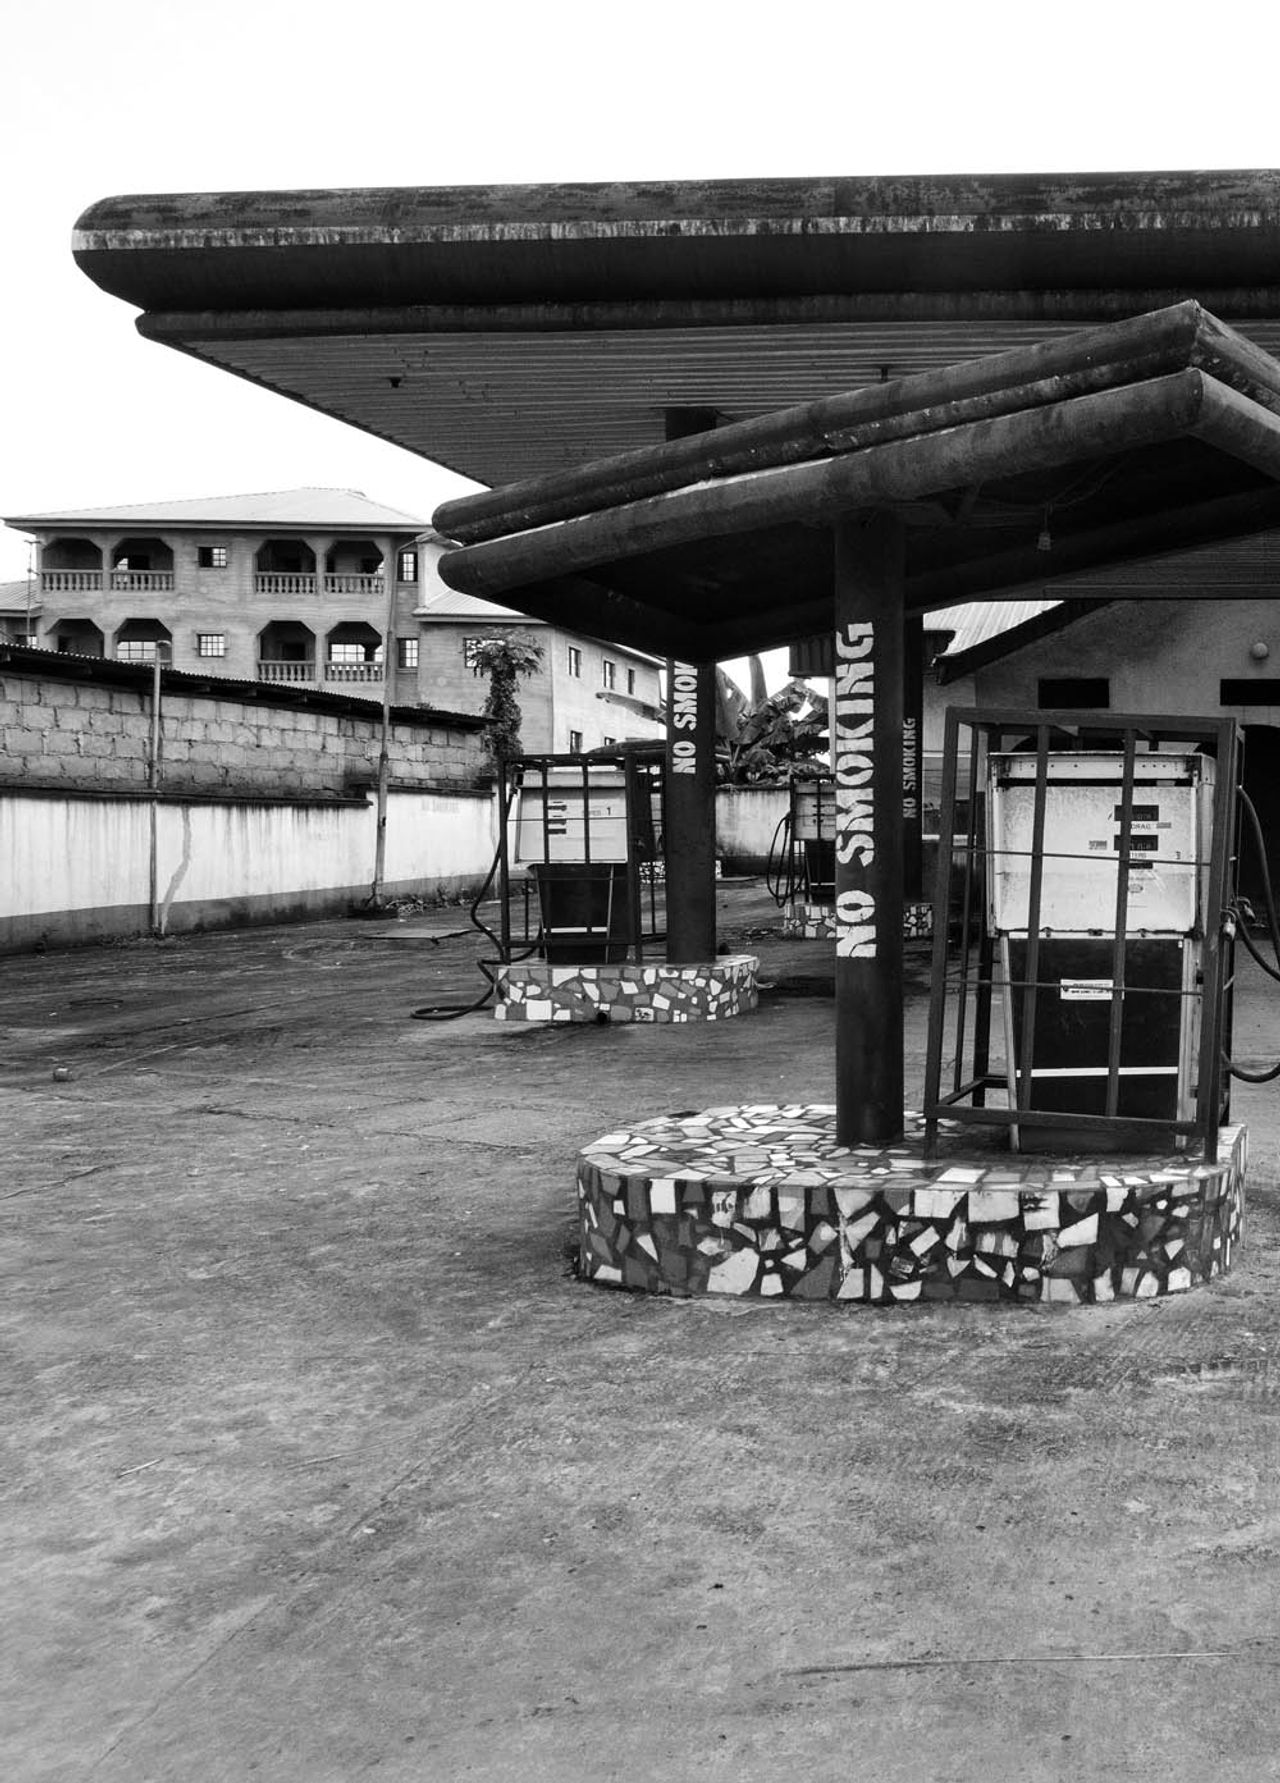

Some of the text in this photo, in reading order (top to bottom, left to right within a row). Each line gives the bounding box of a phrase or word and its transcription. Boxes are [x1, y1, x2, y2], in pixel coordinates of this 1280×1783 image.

[673, 661, 698, 774] NO SMOK
[902, 718, 916, 818] NO SMOKING
[836, 622, 877, 958] NO SMOKING
